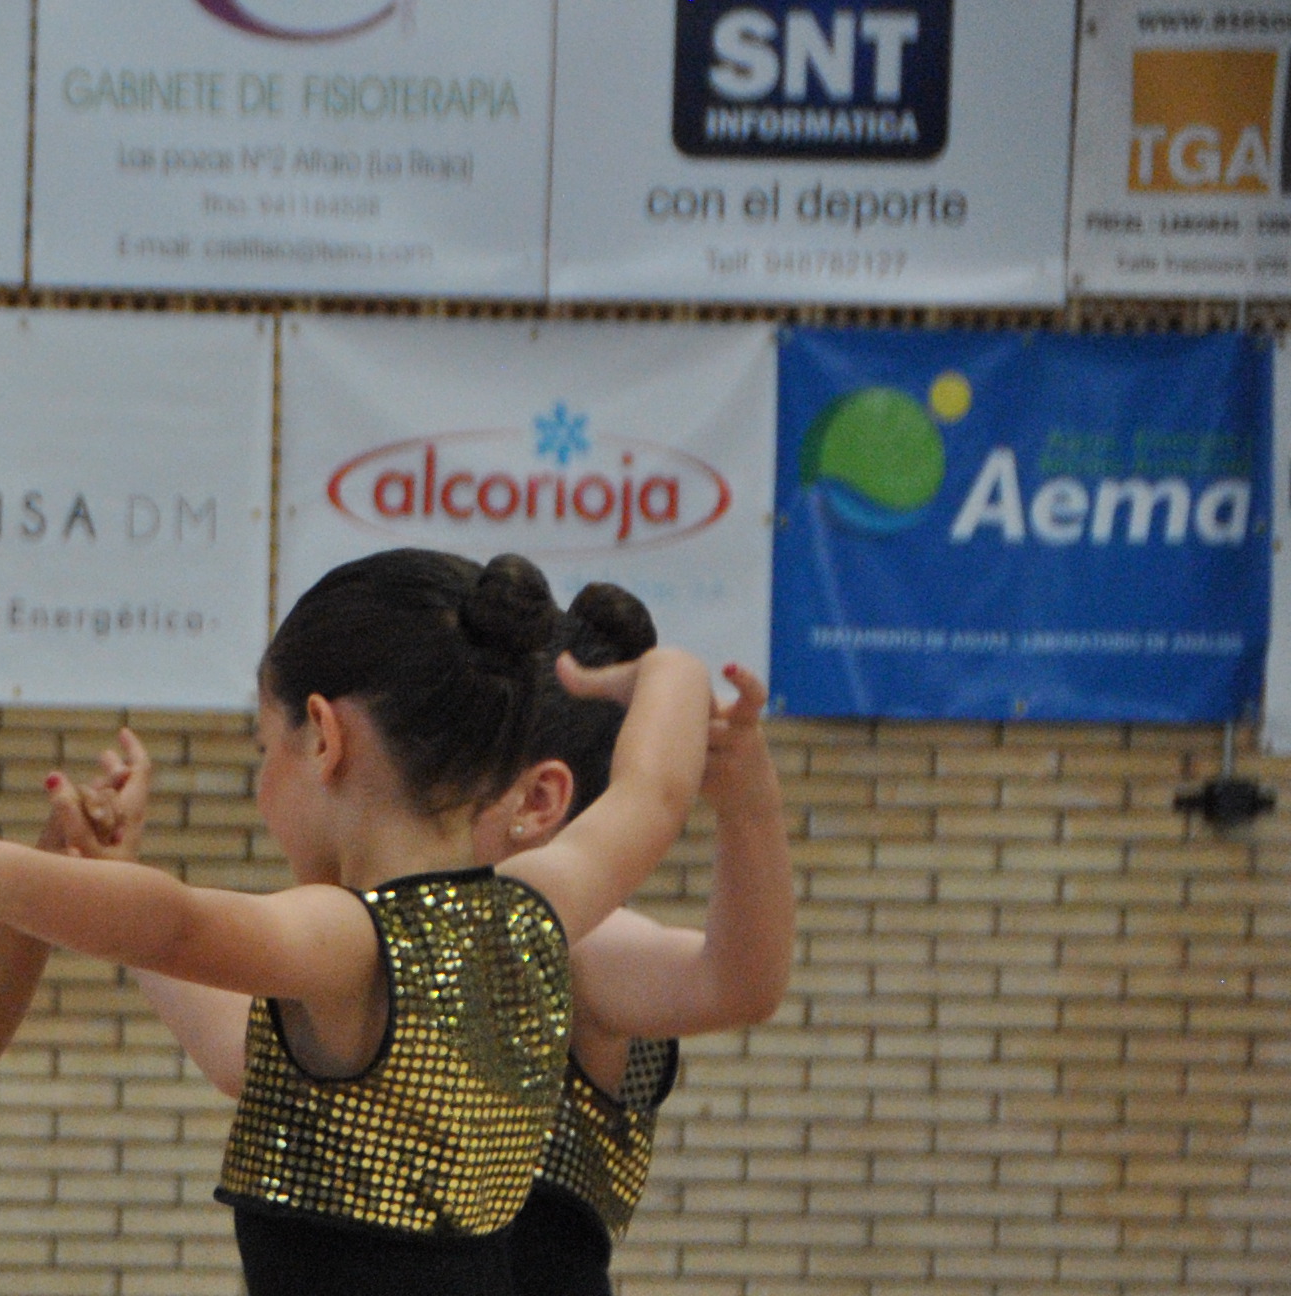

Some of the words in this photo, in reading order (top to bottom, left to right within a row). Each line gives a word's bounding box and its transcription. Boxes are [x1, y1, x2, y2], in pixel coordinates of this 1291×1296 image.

[710, 9, 918, 101] SNT
[61, 67, 227, 114] GABINETE
[240, 72, 286, 115] DE
[304, 74, 520, 121] FISIOTERAPIA
[705, 106, 919, 144] INFORMATICA
[1131, 124, 1270, 187] TGA
[644, 185, 726, 223] con
[742, 179, 781, 223] el
[796, 181, 969, 231] deporte
[125, 494, 220, 543] DM
[373, 442, 680, 543] alcorioja
[949, 446, 1253, 547] Aema
